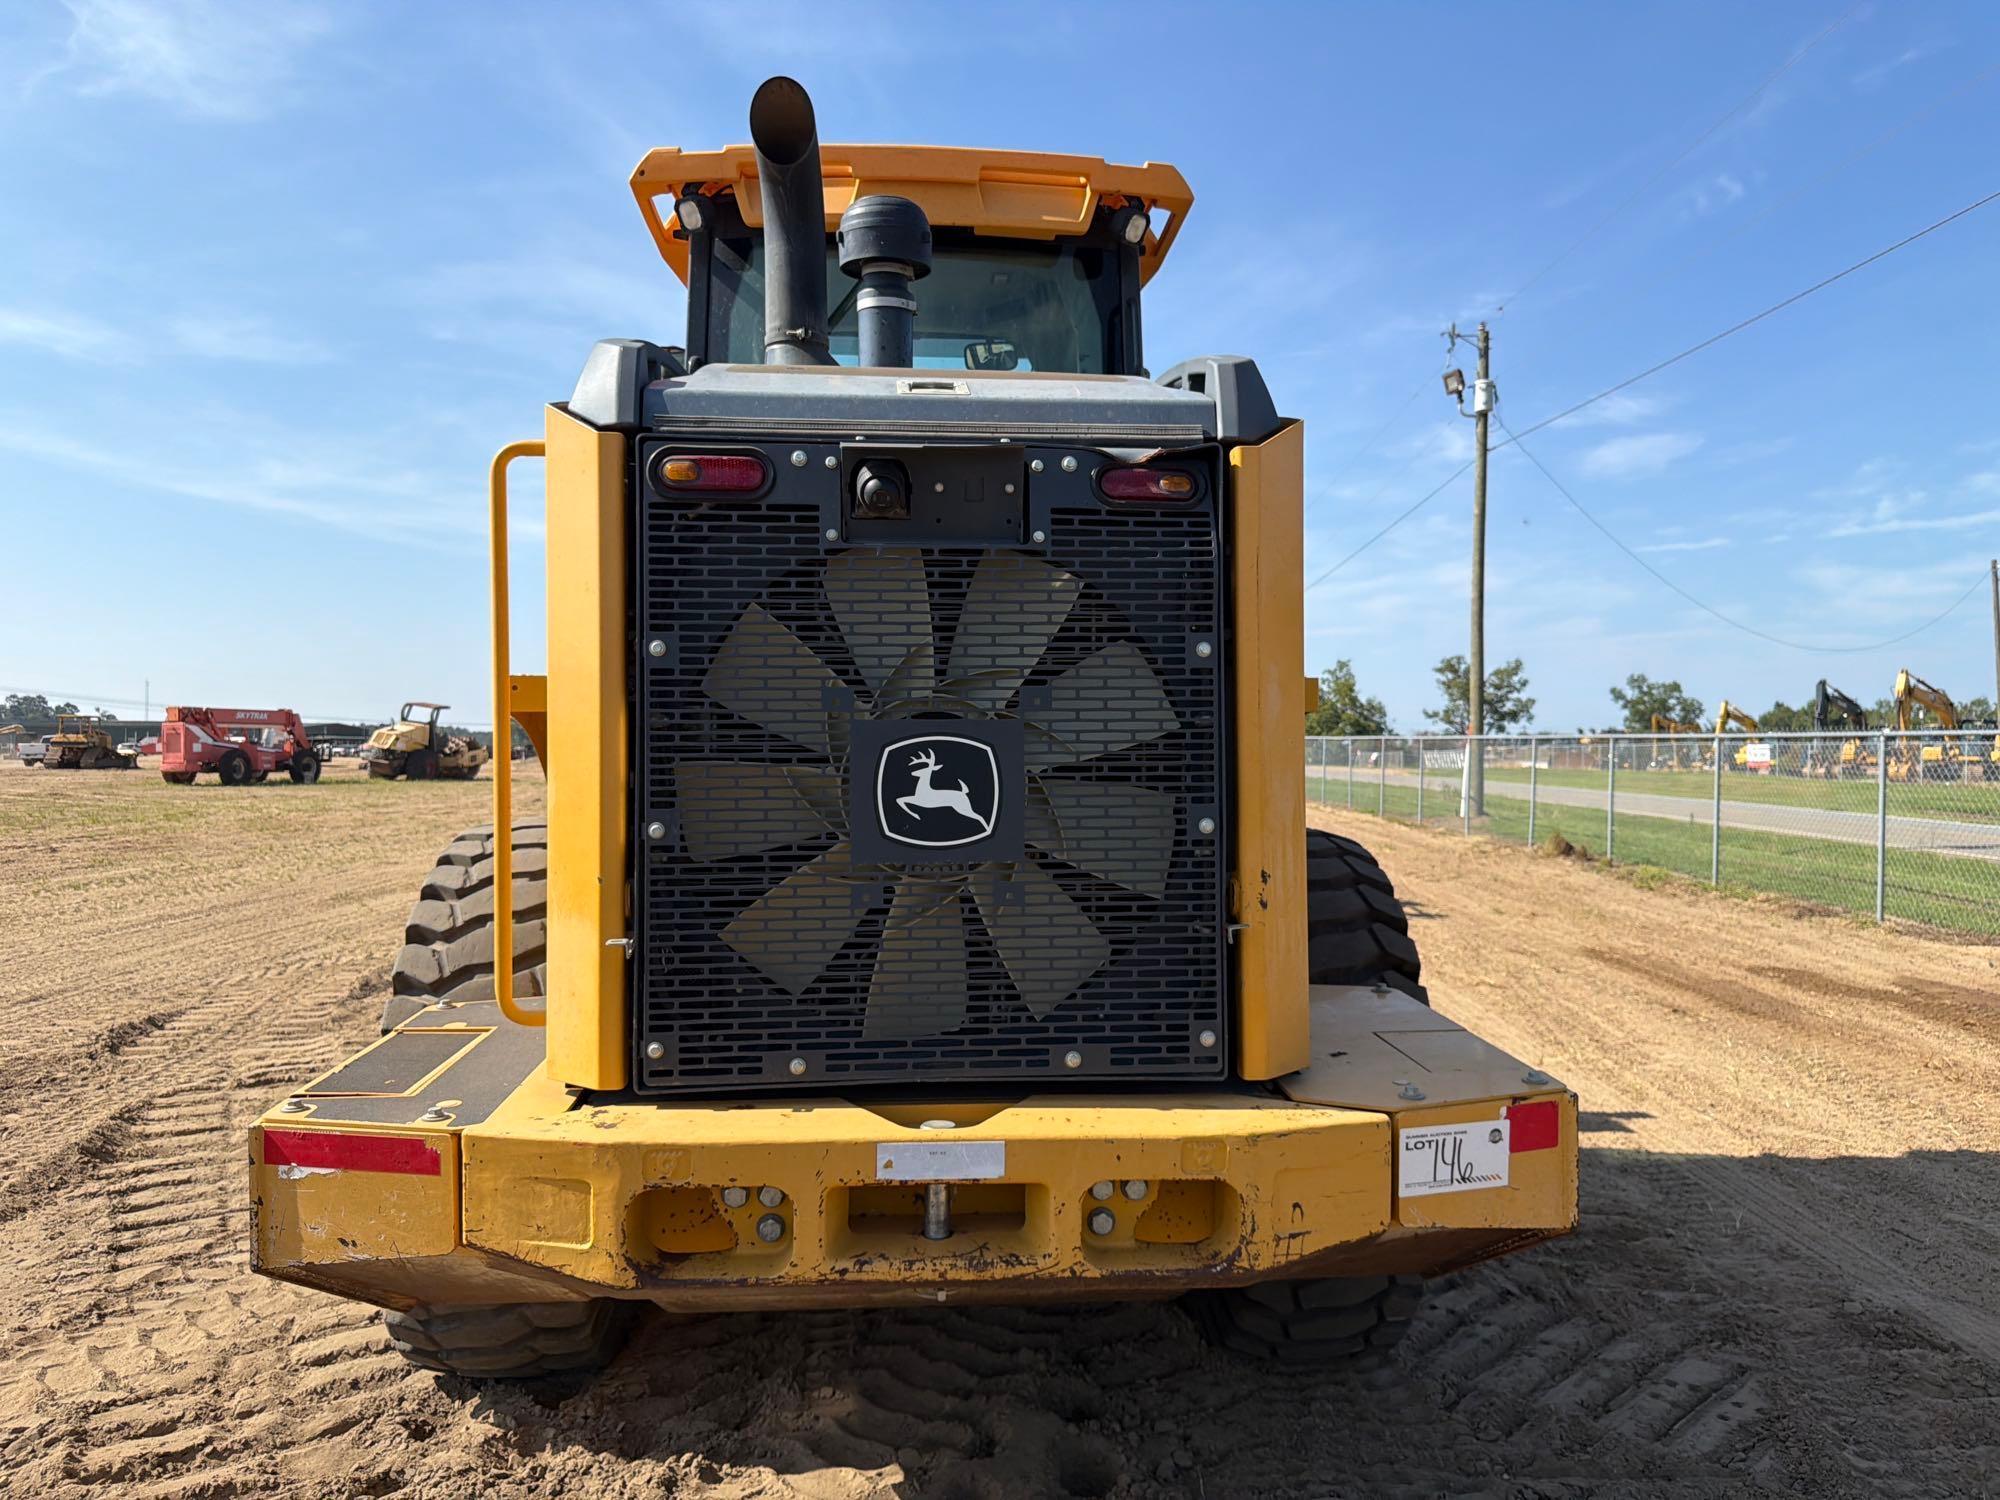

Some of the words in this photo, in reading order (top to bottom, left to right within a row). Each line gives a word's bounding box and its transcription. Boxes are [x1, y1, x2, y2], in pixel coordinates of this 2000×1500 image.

[235, 711, 269, 720] SKYTRAK
[1405, 1139, 1435, 1151] LOT
[1433, 1136, 1473, 1185] 146
